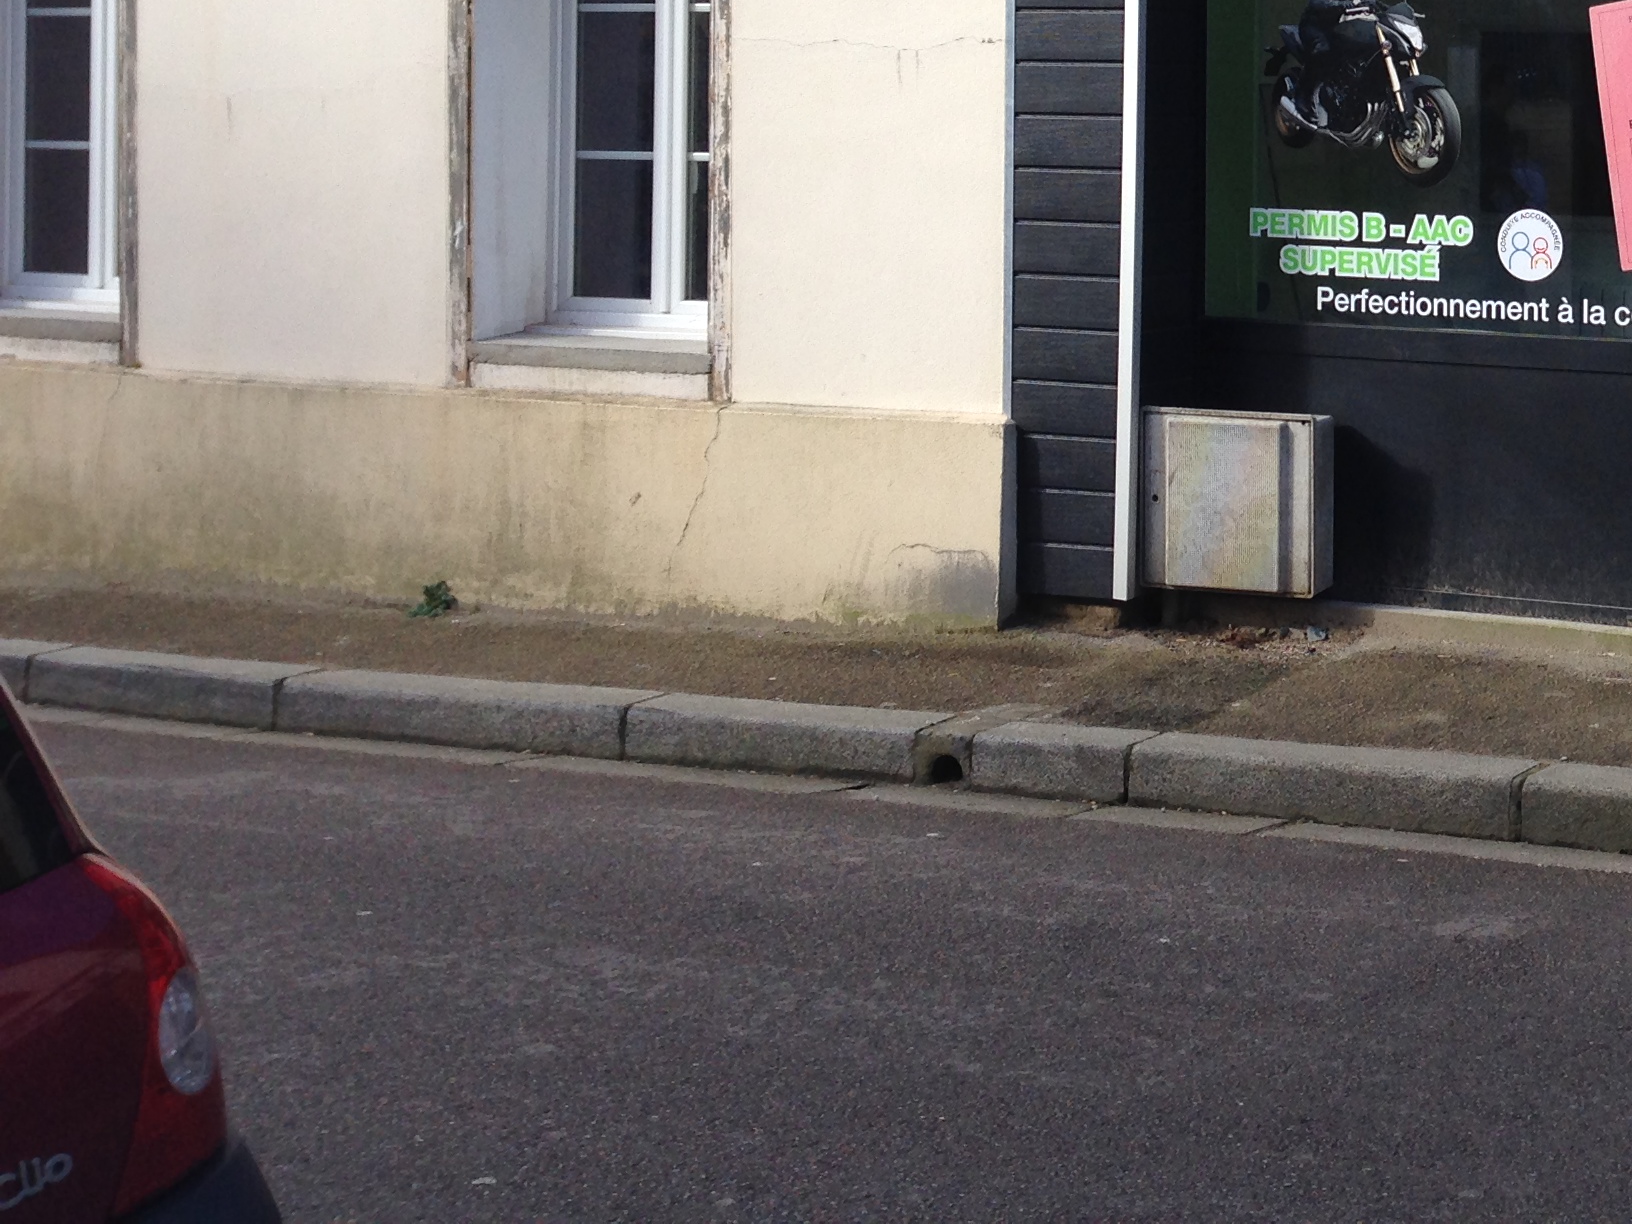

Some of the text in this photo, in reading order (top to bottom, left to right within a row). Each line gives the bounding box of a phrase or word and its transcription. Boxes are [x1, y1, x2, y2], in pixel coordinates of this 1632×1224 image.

[1249, 208, 1359, 241] PERMIS
[1361, 211, 1386, 242] B
[1407, 213, 1474, 247] AAC
[1279, 244, 1441, 281] SUPERVISÉ
[1315, 285, 1549, 324] Perfectionnement
[1557, 296, 1575, 323] à
[1582, 298, 1606, 326] la
